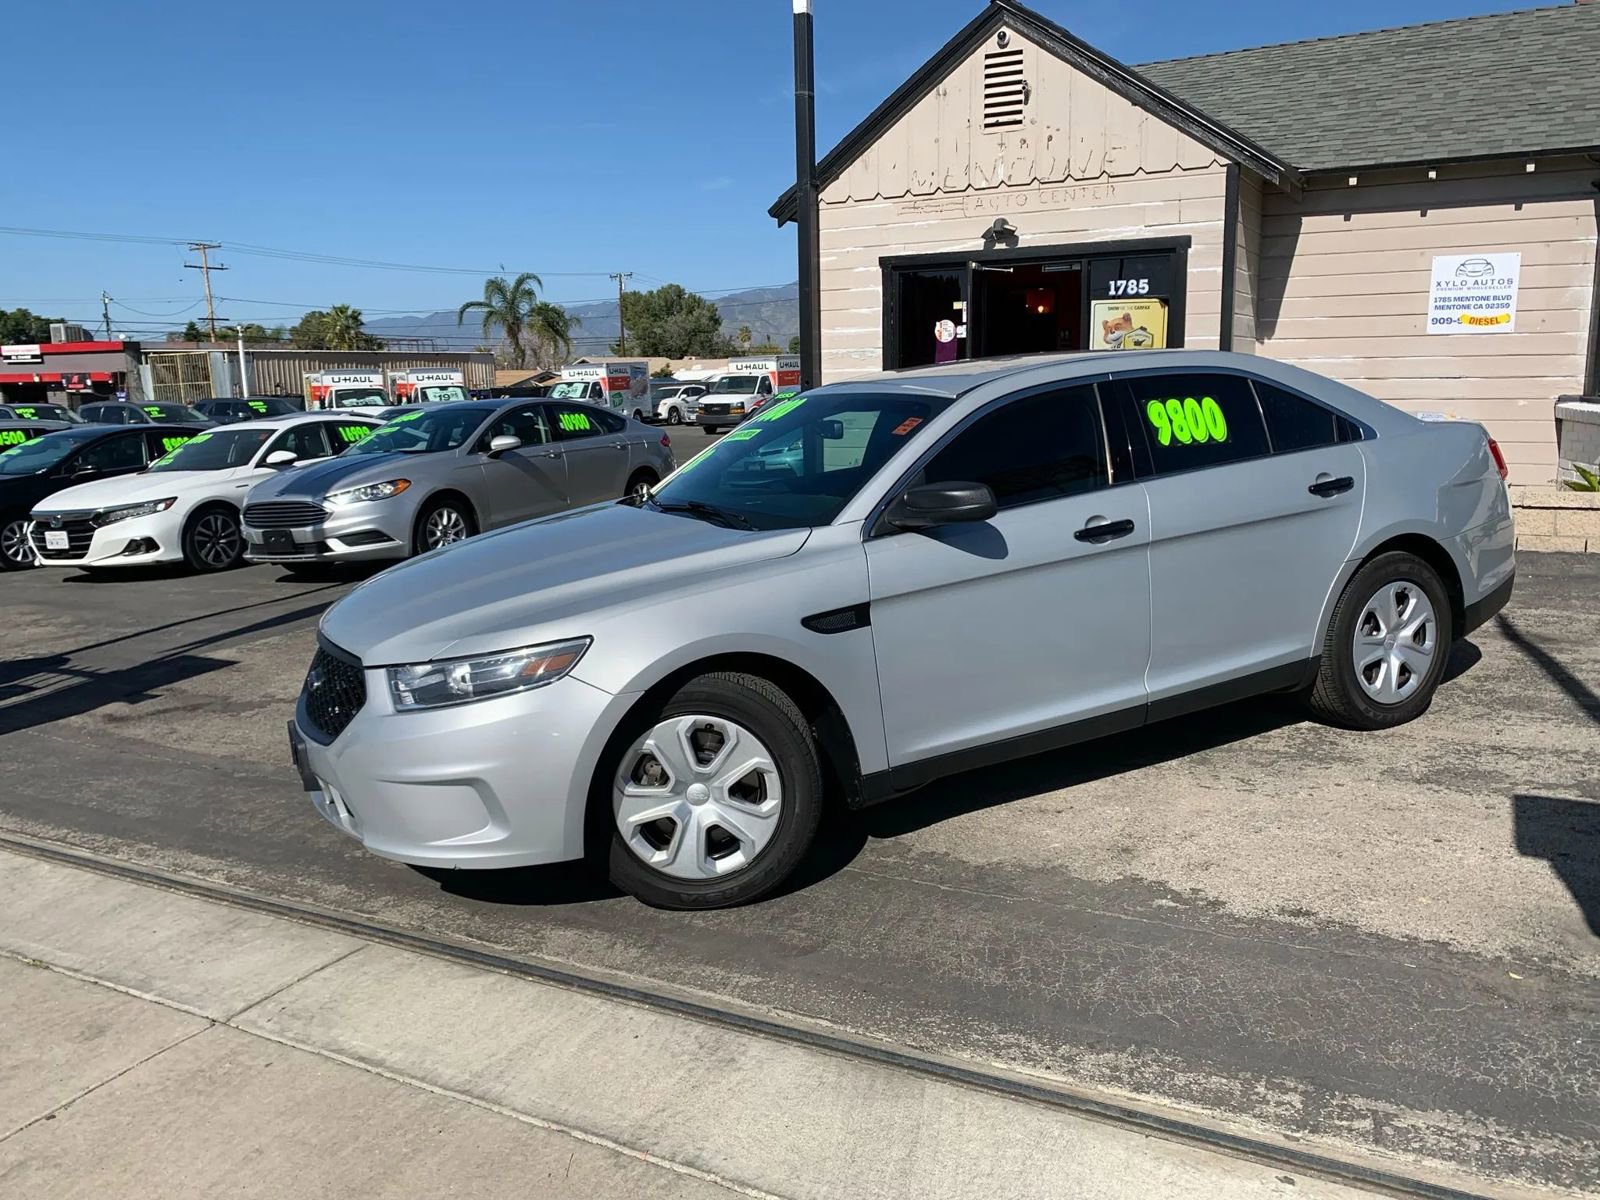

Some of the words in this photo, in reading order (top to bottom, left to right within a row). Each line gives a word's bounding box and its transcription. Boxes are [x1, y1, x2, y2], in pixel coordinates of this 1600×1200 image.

[1472, 278, 1513, 286] AUTOS
[1108, 278, 1150, 296] 1785
[1453, 295, 1491, 303] MENTONE
[1434, 303, 1471, 311] MENTONE
[1473, 302, 1484, 310] CA
[1468, 316, 1502, 326] DIESEL
[736, 363, 769, 371] U-HAUL
[332, 376, 374, 384] U-HAUL
[416, 374, 454, 382] U-HAUL
[1147, 396, 1228, 446] 9800
